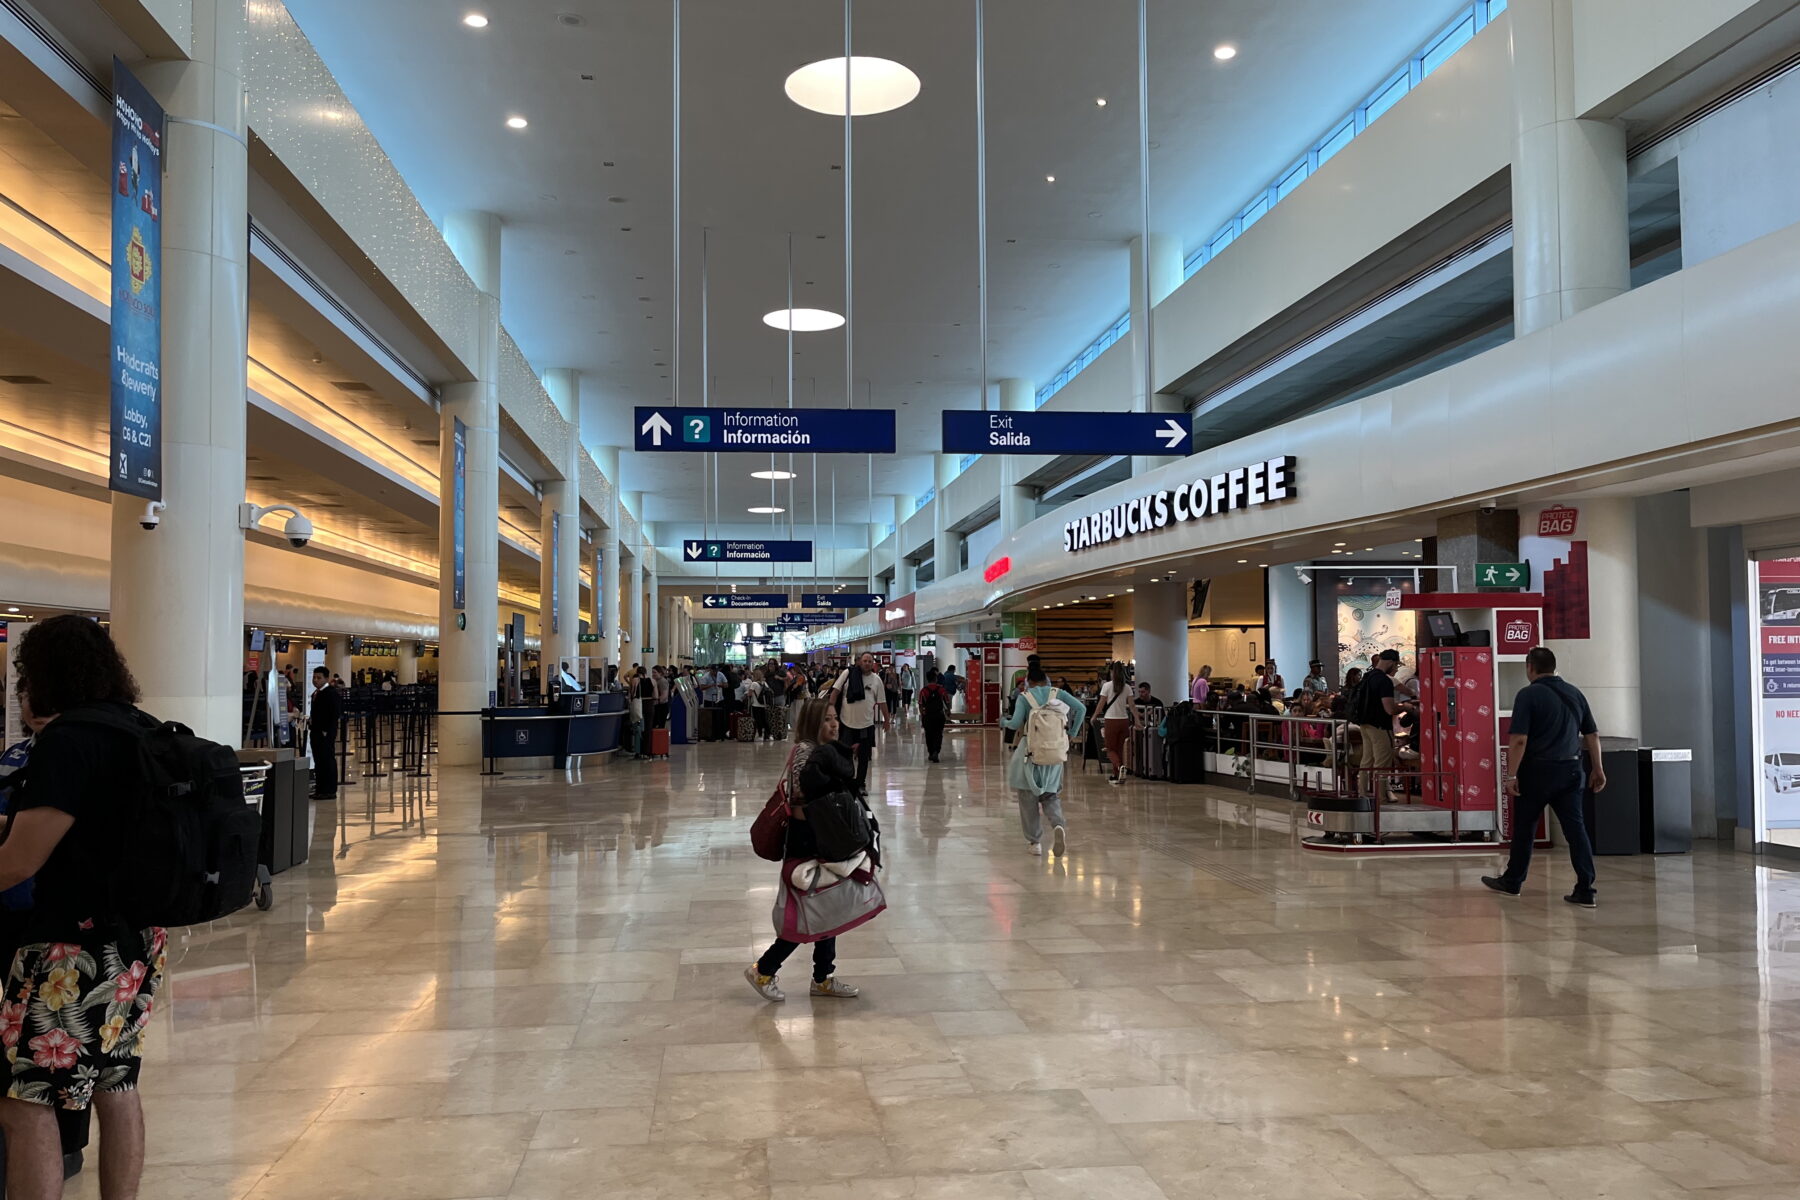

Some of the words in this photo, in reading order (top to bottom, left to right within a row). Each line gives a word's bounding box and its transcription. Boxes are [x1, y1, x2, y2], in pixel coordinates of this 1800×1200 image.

[124, 406, 148, 429] Lobby,
[723, 412, 799, 427] Information
[990, 414, 1013, 429] Exit
[131, 430, 138, 443] &
[138, 432, 152, 448] C21
[723, 429, 811, 445] Información
[989, 431, 1031, 446] Salida
[1063, 490, 1169, 553] STARBUCKS
[1173, 455, 1289, 523] COFFEE
[1541, 510, 1574, 521] PROTEC
[1540, 518, 1573, 534] BAG
[726, 542, 765, 551] Information
[726, 550, 771, 559] Información
[1386, 597, 1400, 607] BAG
[1506, 630, 1529, 640] BAG
[1768, 635, 1787, 644] FREE
[1775, 710, 1786, 719] NO
